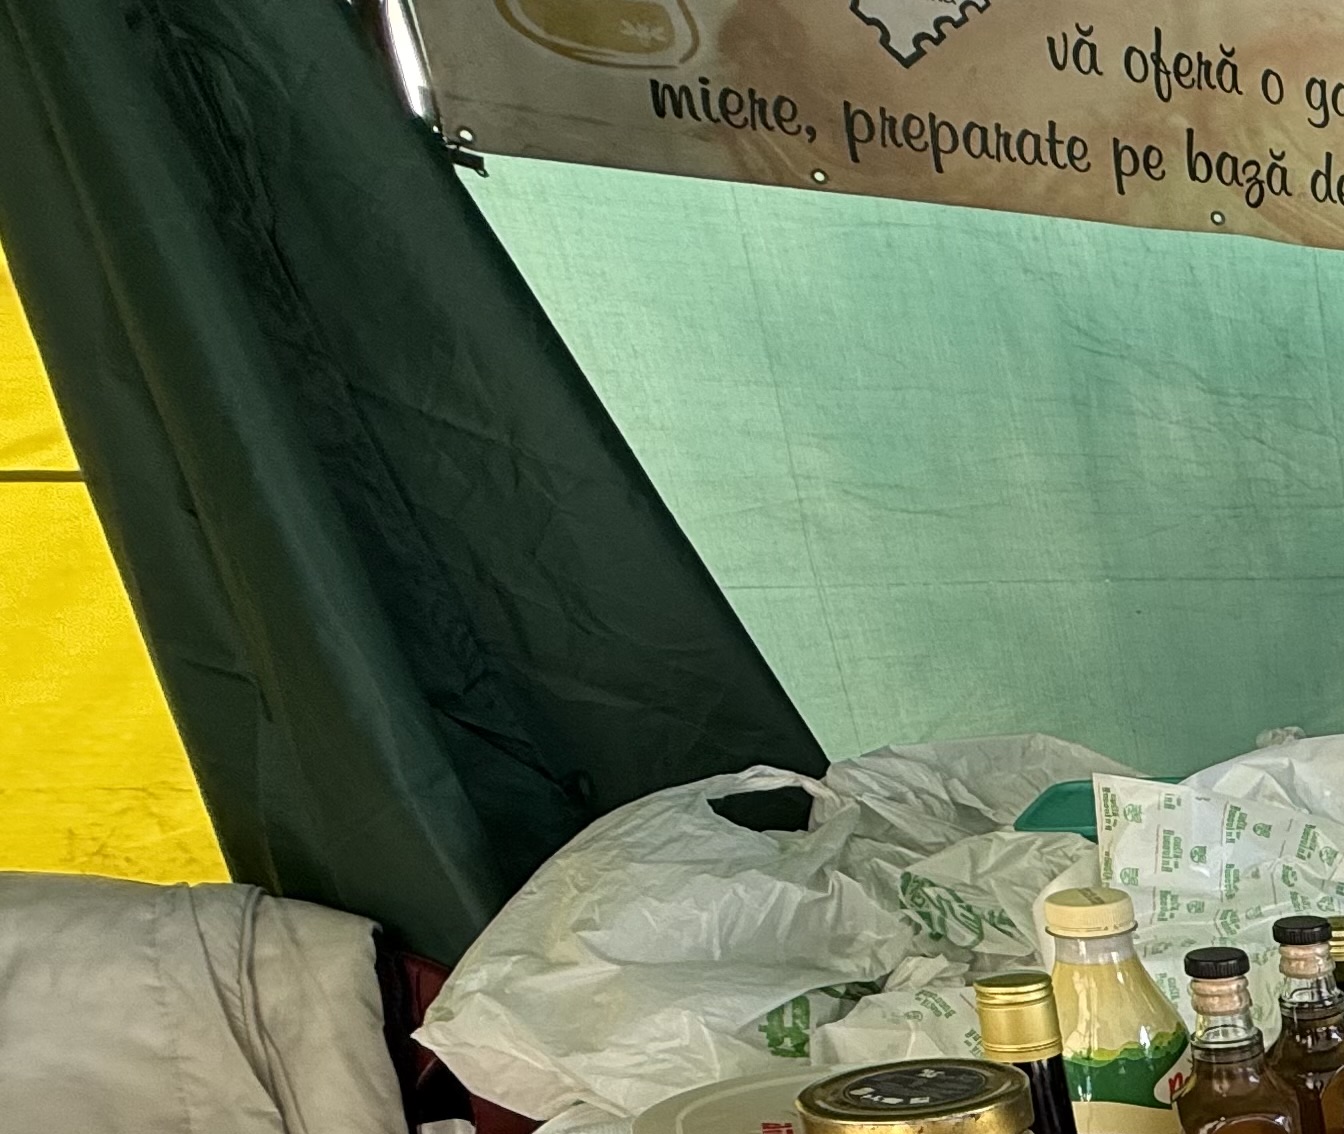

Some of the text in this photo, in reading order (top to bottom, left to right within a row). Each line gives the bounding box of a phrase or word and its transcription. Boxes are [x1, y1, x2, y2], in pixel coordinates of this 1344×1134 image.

[1048, 23, 1103, 77] vă
[1125, 28, 1243, 103] oferă
[1262, 68, 1284, 104] o
[651, 77, 817, 143] miere,
[844, 100, 1091, 173] preparate
[1114, 138, 1167, 193] pe
[1186, 129, 1292, 208] bază
